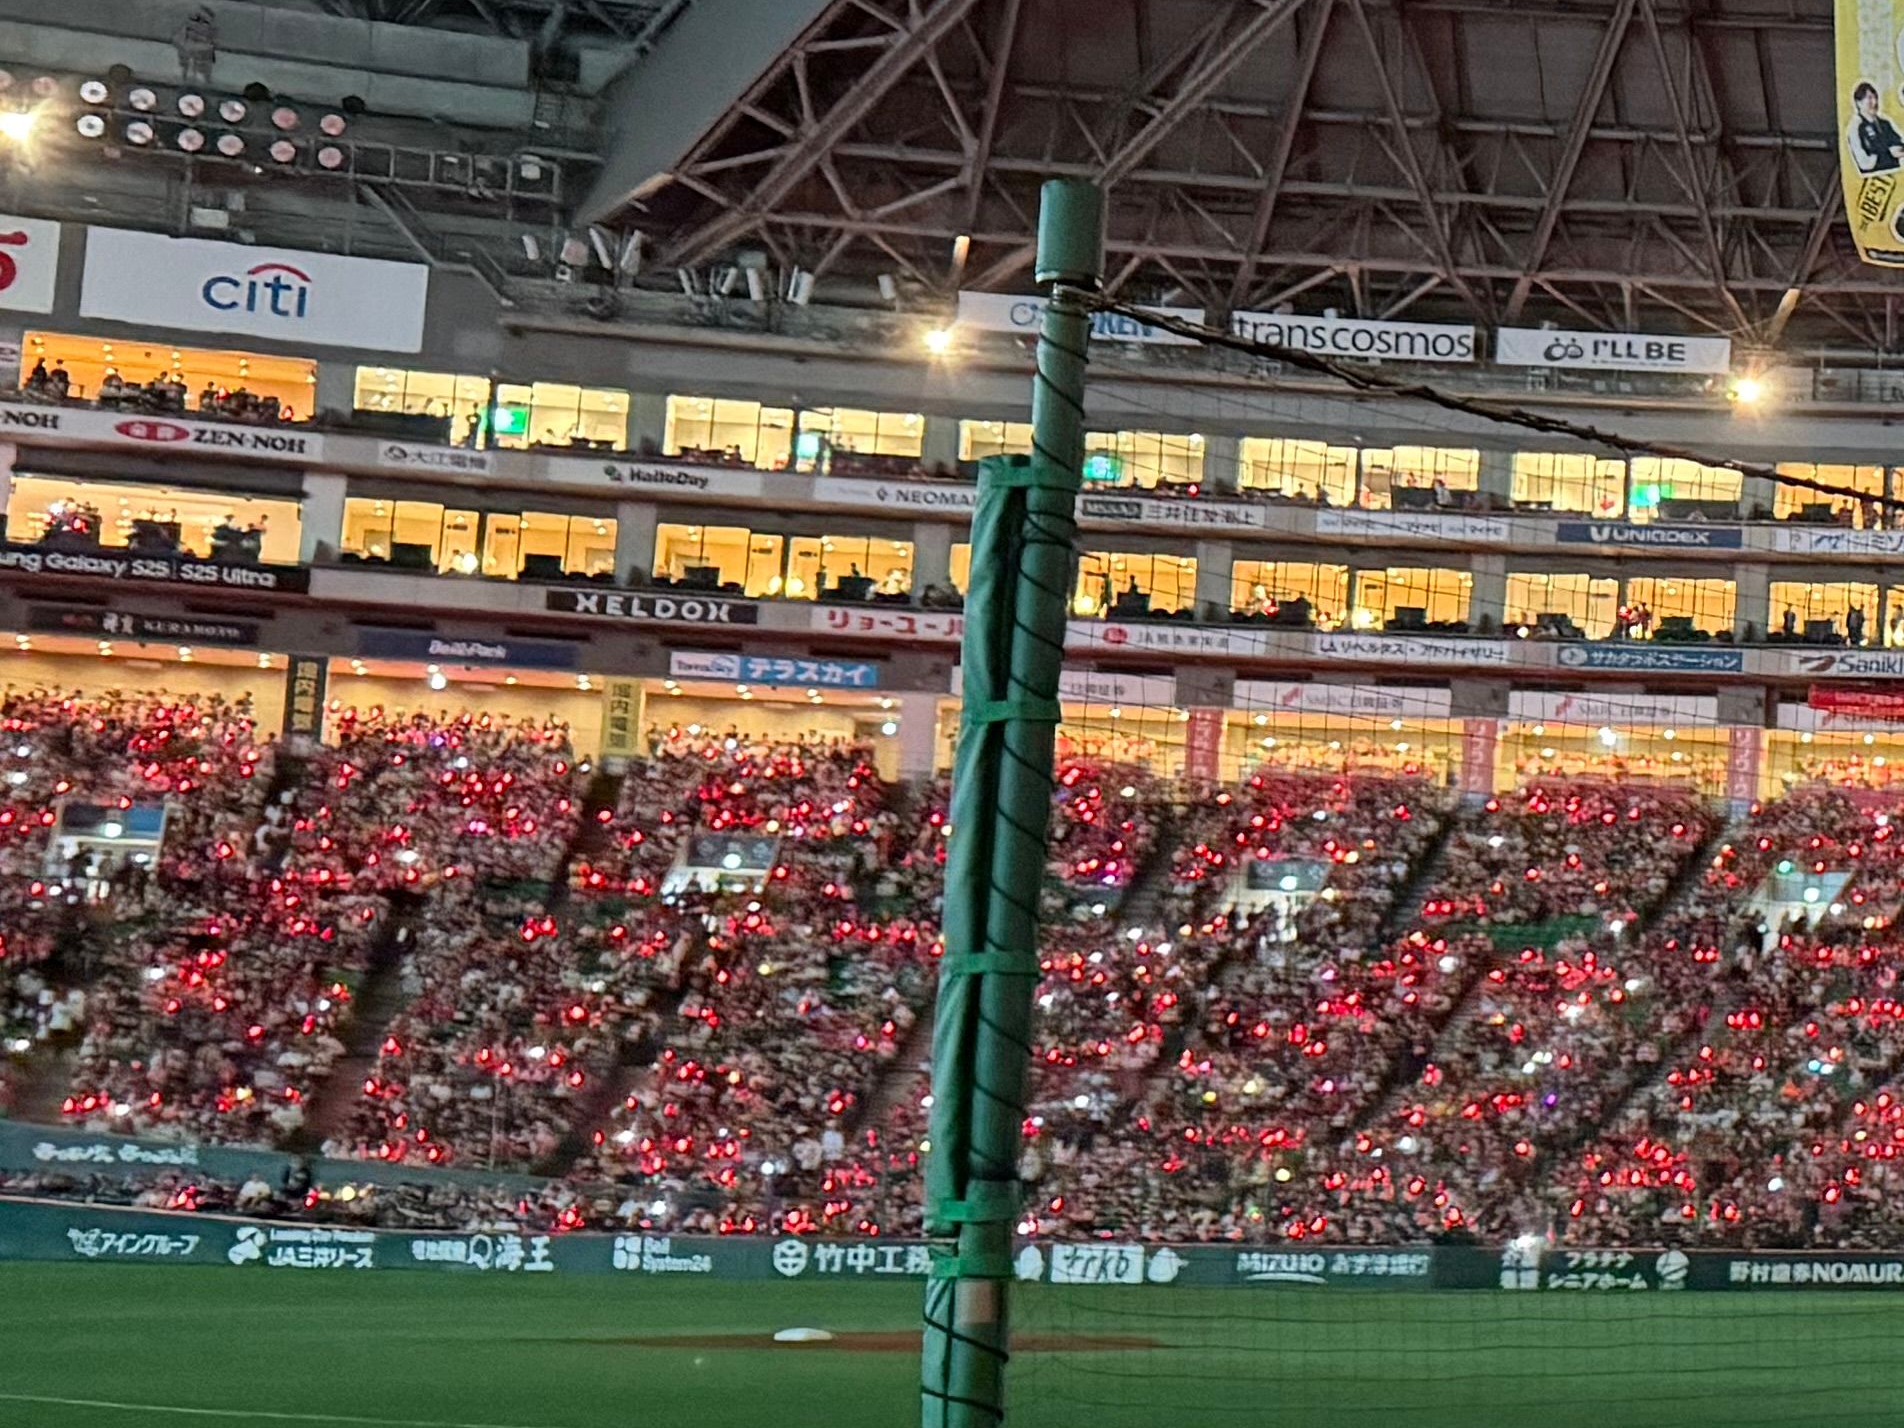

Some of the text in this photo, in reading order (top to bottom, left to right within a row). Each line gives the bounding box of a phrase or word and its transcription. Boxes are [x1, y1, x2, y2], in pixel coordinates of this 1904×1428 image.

[203, 263, 312, 317] citi
[1645, 342, 1686, 361] BE
[0, 410, 60, 430] -NOH
[895, 488, 977, 507] NEOMA
[46, 553, 128, 578] Galaxy
[131, 561, 171, 577] S25
[180, 565, 219, 582] S25
[222, 568, 277, 588] Ultra
[747, 658, 870, 685] テラスカイ
[100, 1232, 200, 1256] アイングループ
[814, 1243, 935, 1274] 竹中工務
